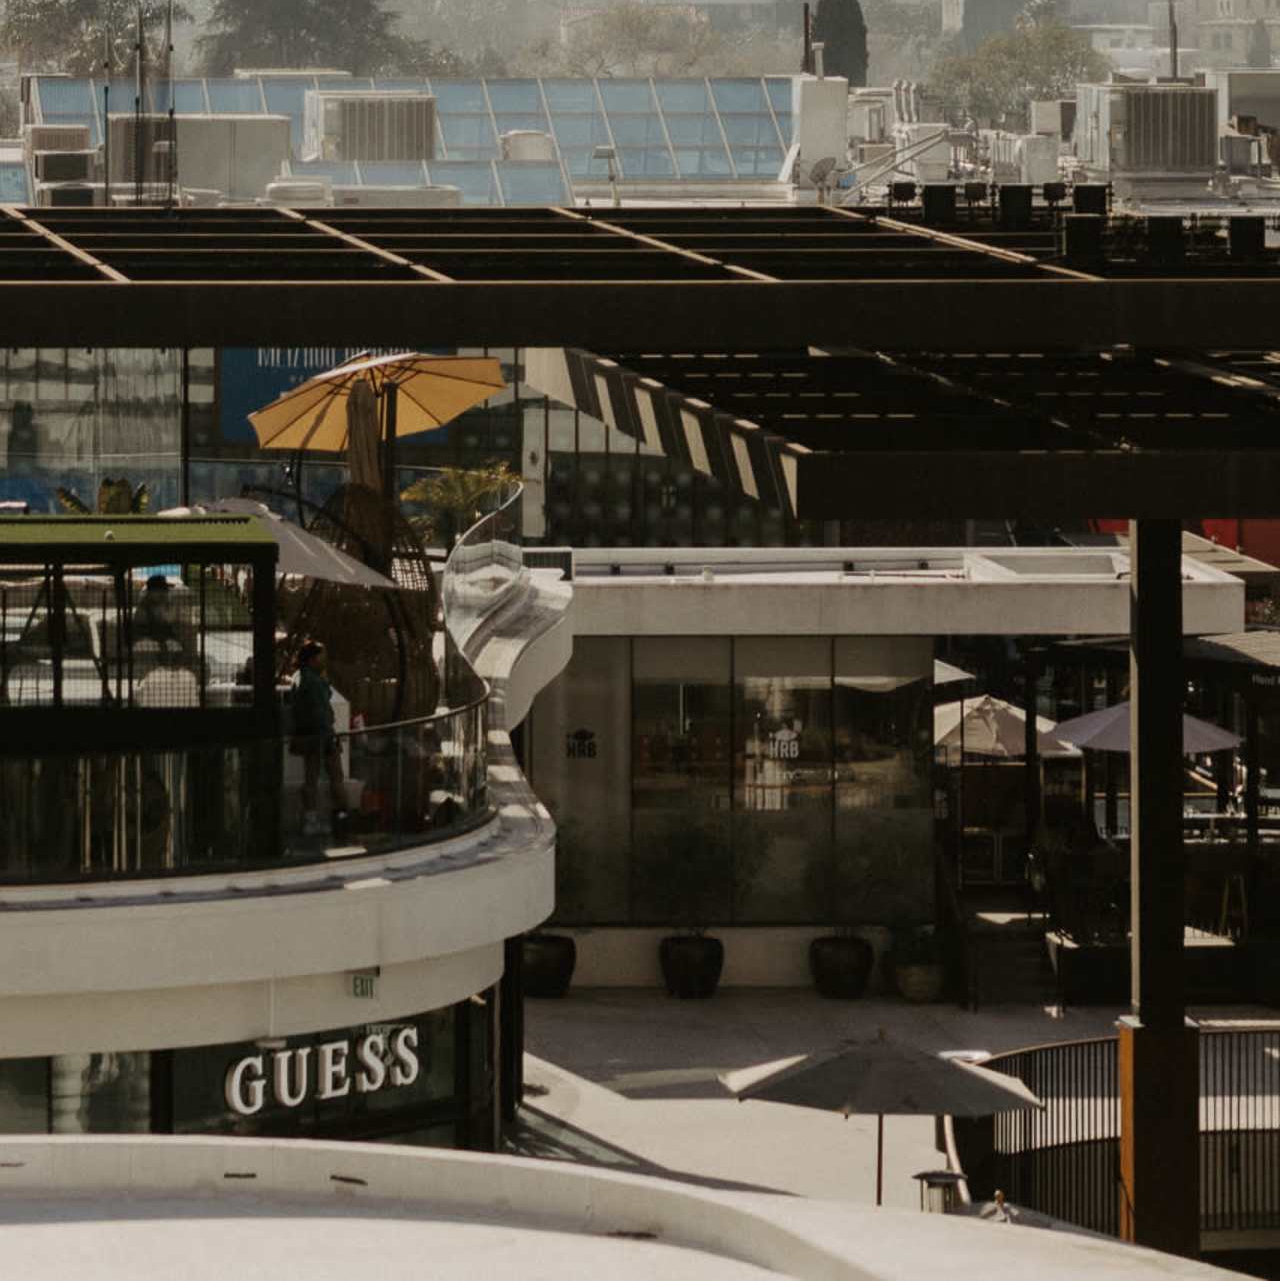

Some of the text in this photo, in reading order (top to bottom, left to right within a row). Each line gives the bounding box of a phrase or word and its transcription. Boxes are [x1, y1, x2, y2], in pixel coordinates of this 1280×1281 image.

[768, 740, 799, 759] HRB
[353, 976, 374, 998] EXIT
[226, 1027, 419, 1115] GUESS
